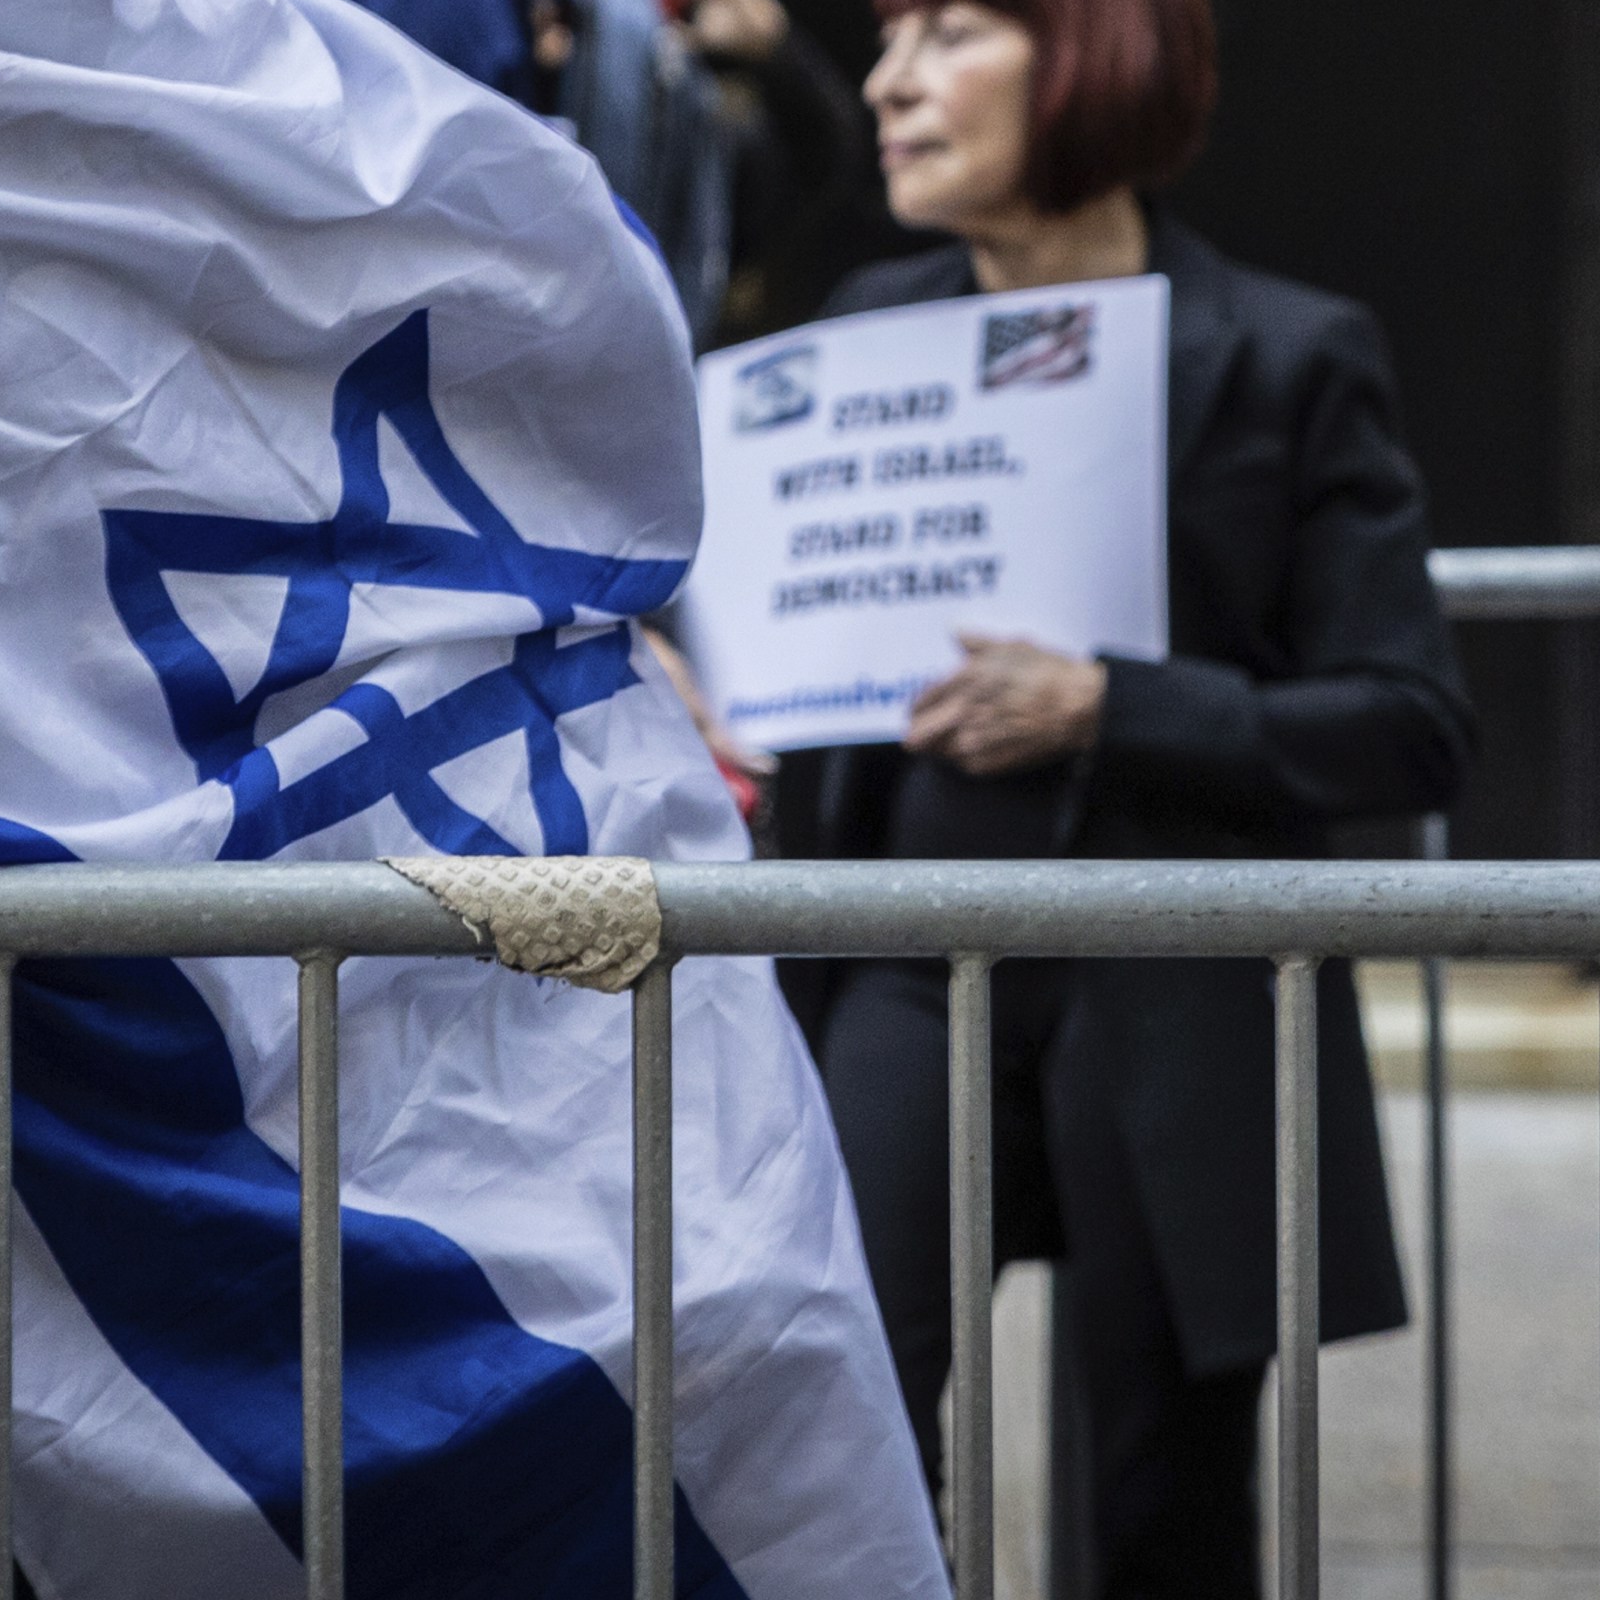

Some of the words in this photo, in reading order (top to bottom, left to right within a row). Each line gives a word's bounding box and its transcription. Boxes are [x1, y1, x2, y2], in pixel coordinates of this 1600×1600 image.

[832, 385, 952, 429] STAND
[777, 457, 860, 496] WITH
[790, 512, 899, 557] STAND
[914, 504, 987, 543] FOR
[775, 555, 1001, 615] DEMOCRACY
